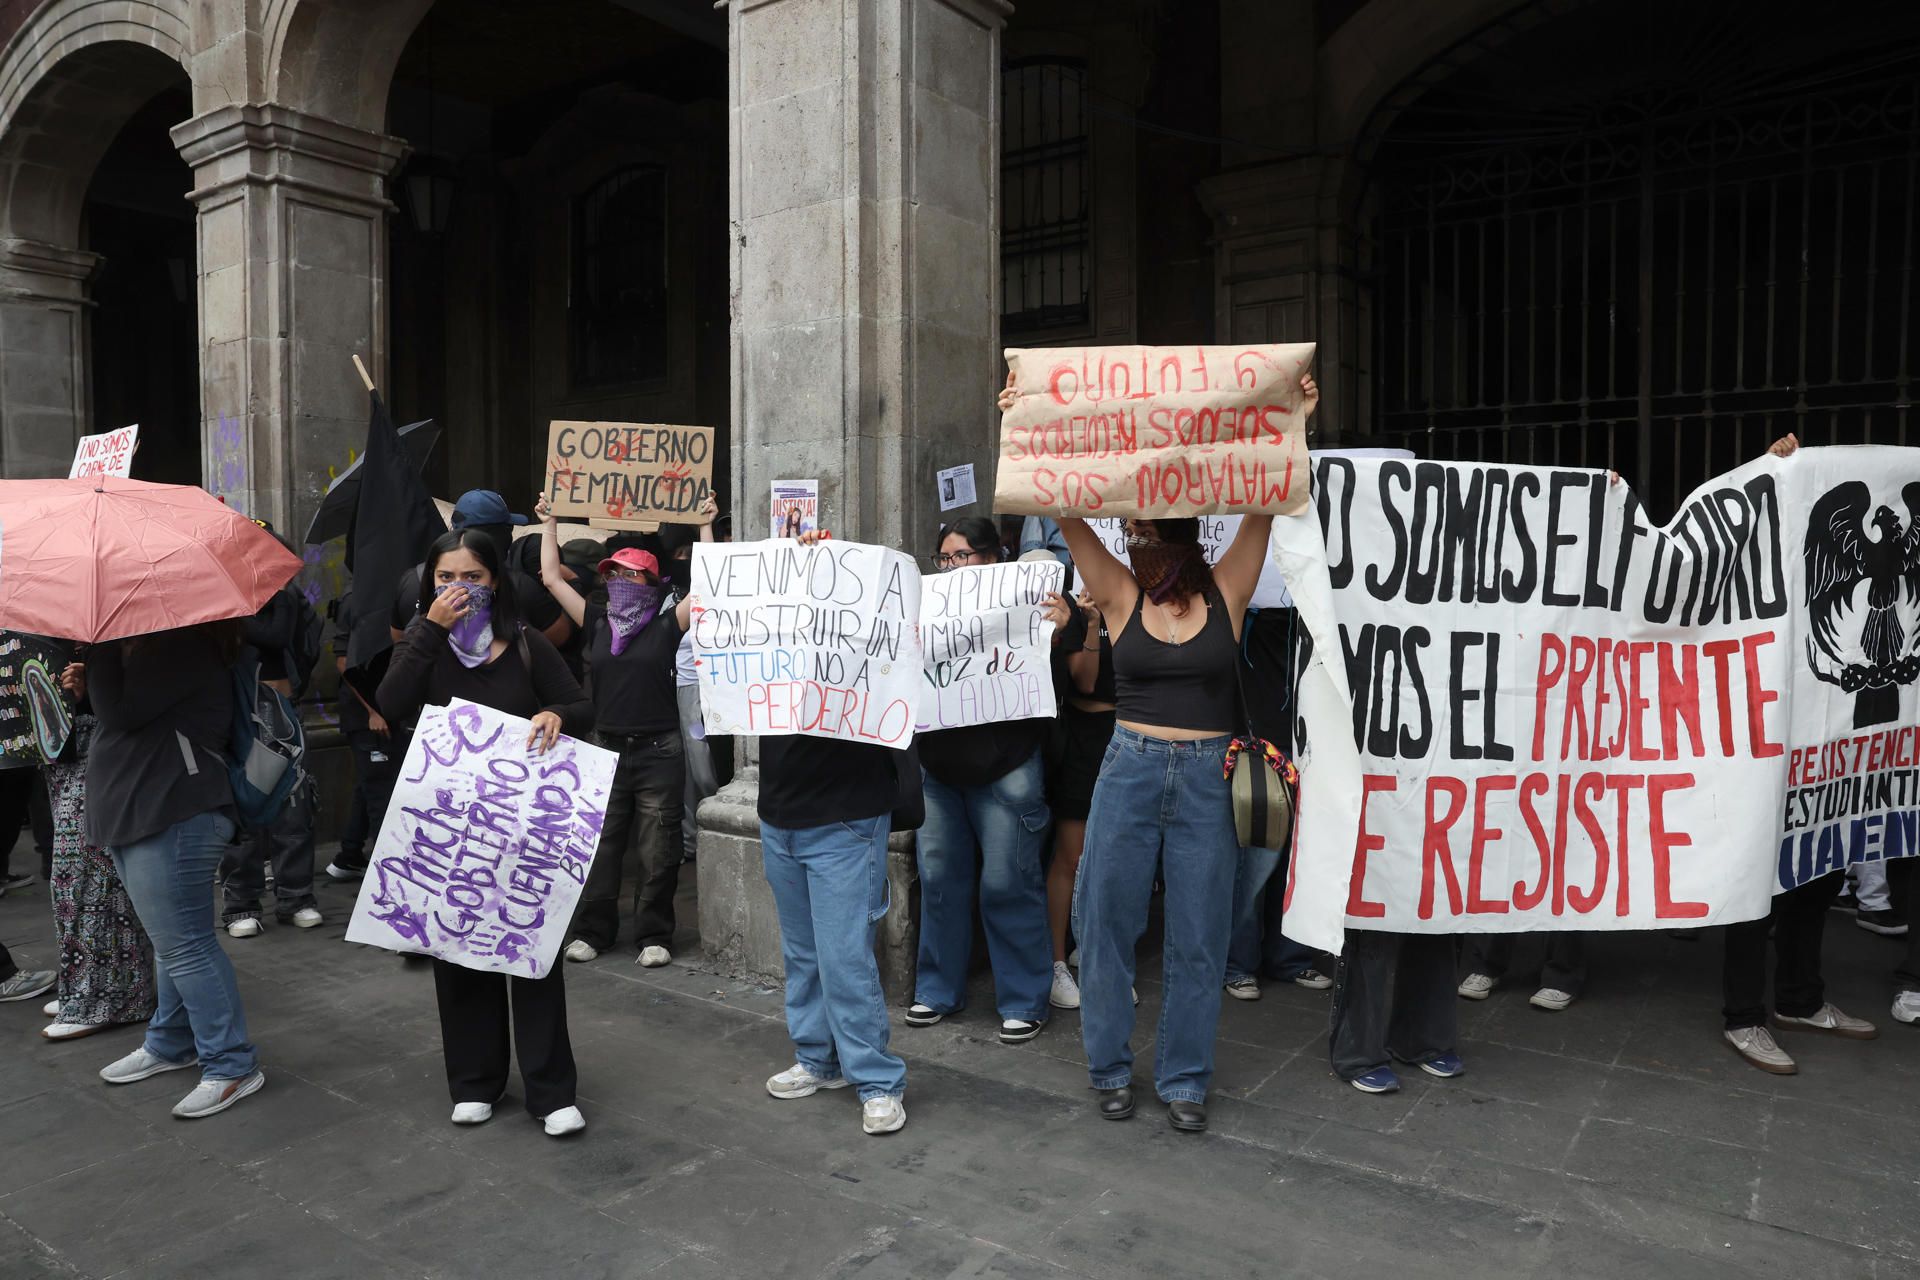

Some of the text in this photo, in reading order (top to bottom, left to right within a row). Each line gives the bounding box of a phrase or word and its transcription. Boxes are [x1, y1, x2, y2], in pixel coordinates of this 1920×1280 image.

[1048, 349, 1209, 406] FUTURO
[108, 453, 125, 471] DE
[557, 428, 707, 464] GOBIERNO
[1008, 407, 1138, 461] RECUERDOS
[551, 471, 710, 512] FEMINICIDA
[1031, 468, 1109, 510] SUS
[1136, 452, 1292, 508] MATARON
[1310, 457, 1788, 627] O SOMOS EL FUTURO
[701, 546, 905, 619] VENIMOS A
[696, 603, 901, 661] CONSTRUIR UN
[814, 651, 845, 684] NO
[853, 658, 869, 692] A
[1338, 623, 1784, 762] MOS EL PRESENTE
[747, 681, 909, 742] PERDERLO
[915, 672, 1041, 729] LAUDIA
[1788, 726, 1920, 787] RESISTENCI
[1783, 769, 1920, 832] ESTUDIANTI
[435, 759, 529, 937] GOBIERNO
[1417, 772, 1710, 920] RESISTE
